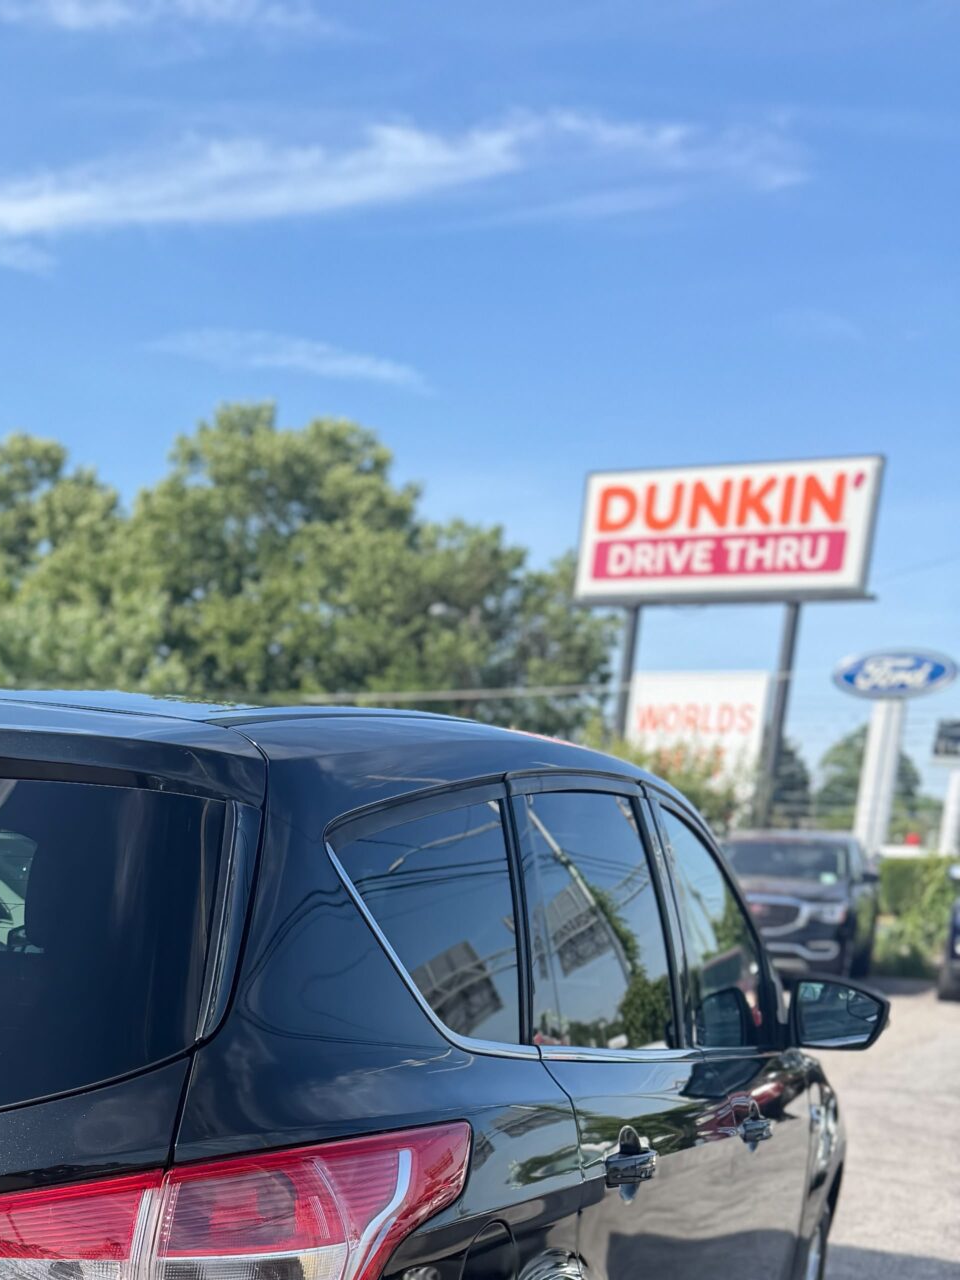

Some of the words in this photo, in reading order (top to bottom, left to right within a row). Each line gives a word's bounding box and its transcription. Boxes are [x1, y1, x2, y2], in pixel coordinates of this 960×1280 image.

[596, 471, 865, 533] DUNKIN'
[605, 539, 716, 576] DRIVE
[722, 534, 830, 572] THRU
[635, 702, 756, 736] WORLDS
